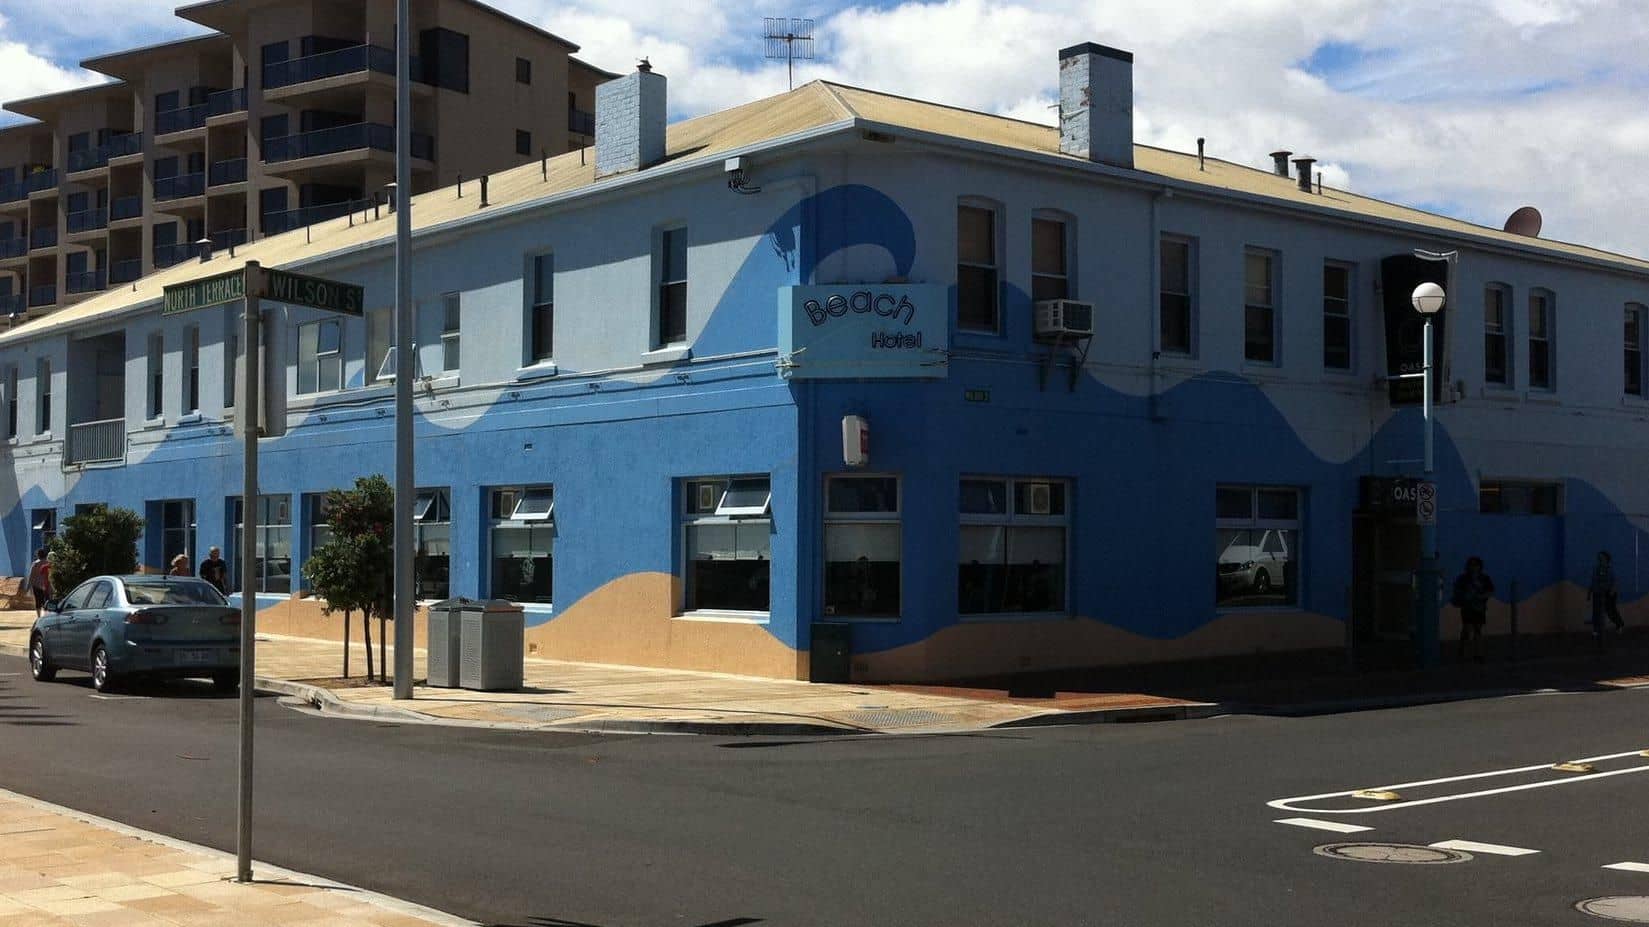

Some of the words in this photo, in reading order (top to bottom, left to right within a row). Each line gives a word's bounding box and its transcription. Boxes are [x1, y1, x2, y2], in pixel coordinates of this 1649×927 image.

[163, 286, 197, 313] NORTH
[202, 275, 243, 305] TERRACE
[271, 271, 340, 308] WILSON
[803, 290, 915, 327] Beach
[871, 331, 923, 349] Hotel
[1393, 486, 1418, 501] OAS
